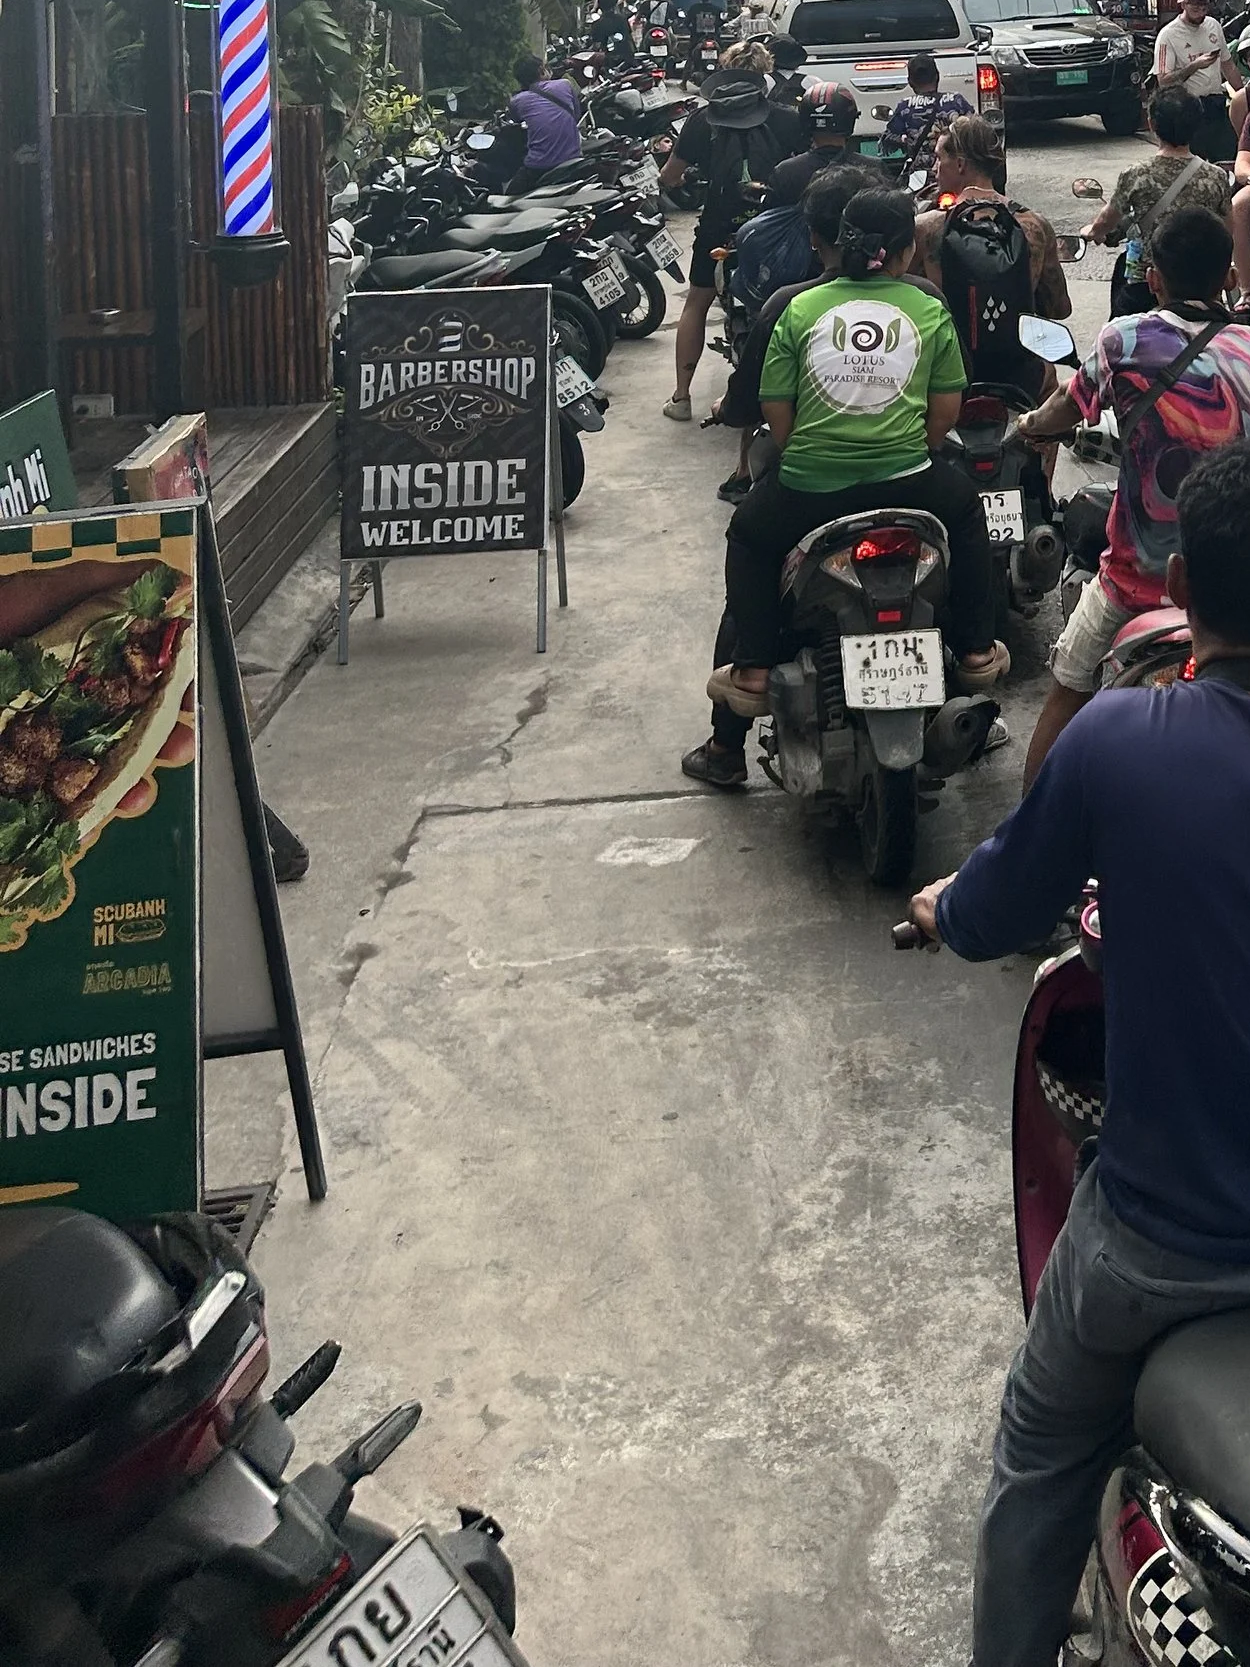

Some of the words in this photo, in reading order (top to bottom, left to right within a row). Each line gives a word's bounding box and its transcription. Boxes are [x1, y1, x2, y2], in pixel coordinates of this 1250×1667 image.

[600, 287, 621, 306] 4105
[843, 355, 885, 366] LOTUS
[359, 356, 536, 410] BARBERSHOP
[824, 375, 866, 383] PARADISE
[557, 380, 592, 404] 8512
[579, 403, 591, 416] 3
[360, 458, 527, 512] INSIDE
[360, 514, 525, 547] WELCOME
[93, 899, 166, 923] SCUBANH
[94, 924, 114, 946] MI
[83, 963, 172, 994] ARCADIA
[30, 1033, 157, 1070] SANDWICHES
[0, 1067, 157, 1138] NSIDE
